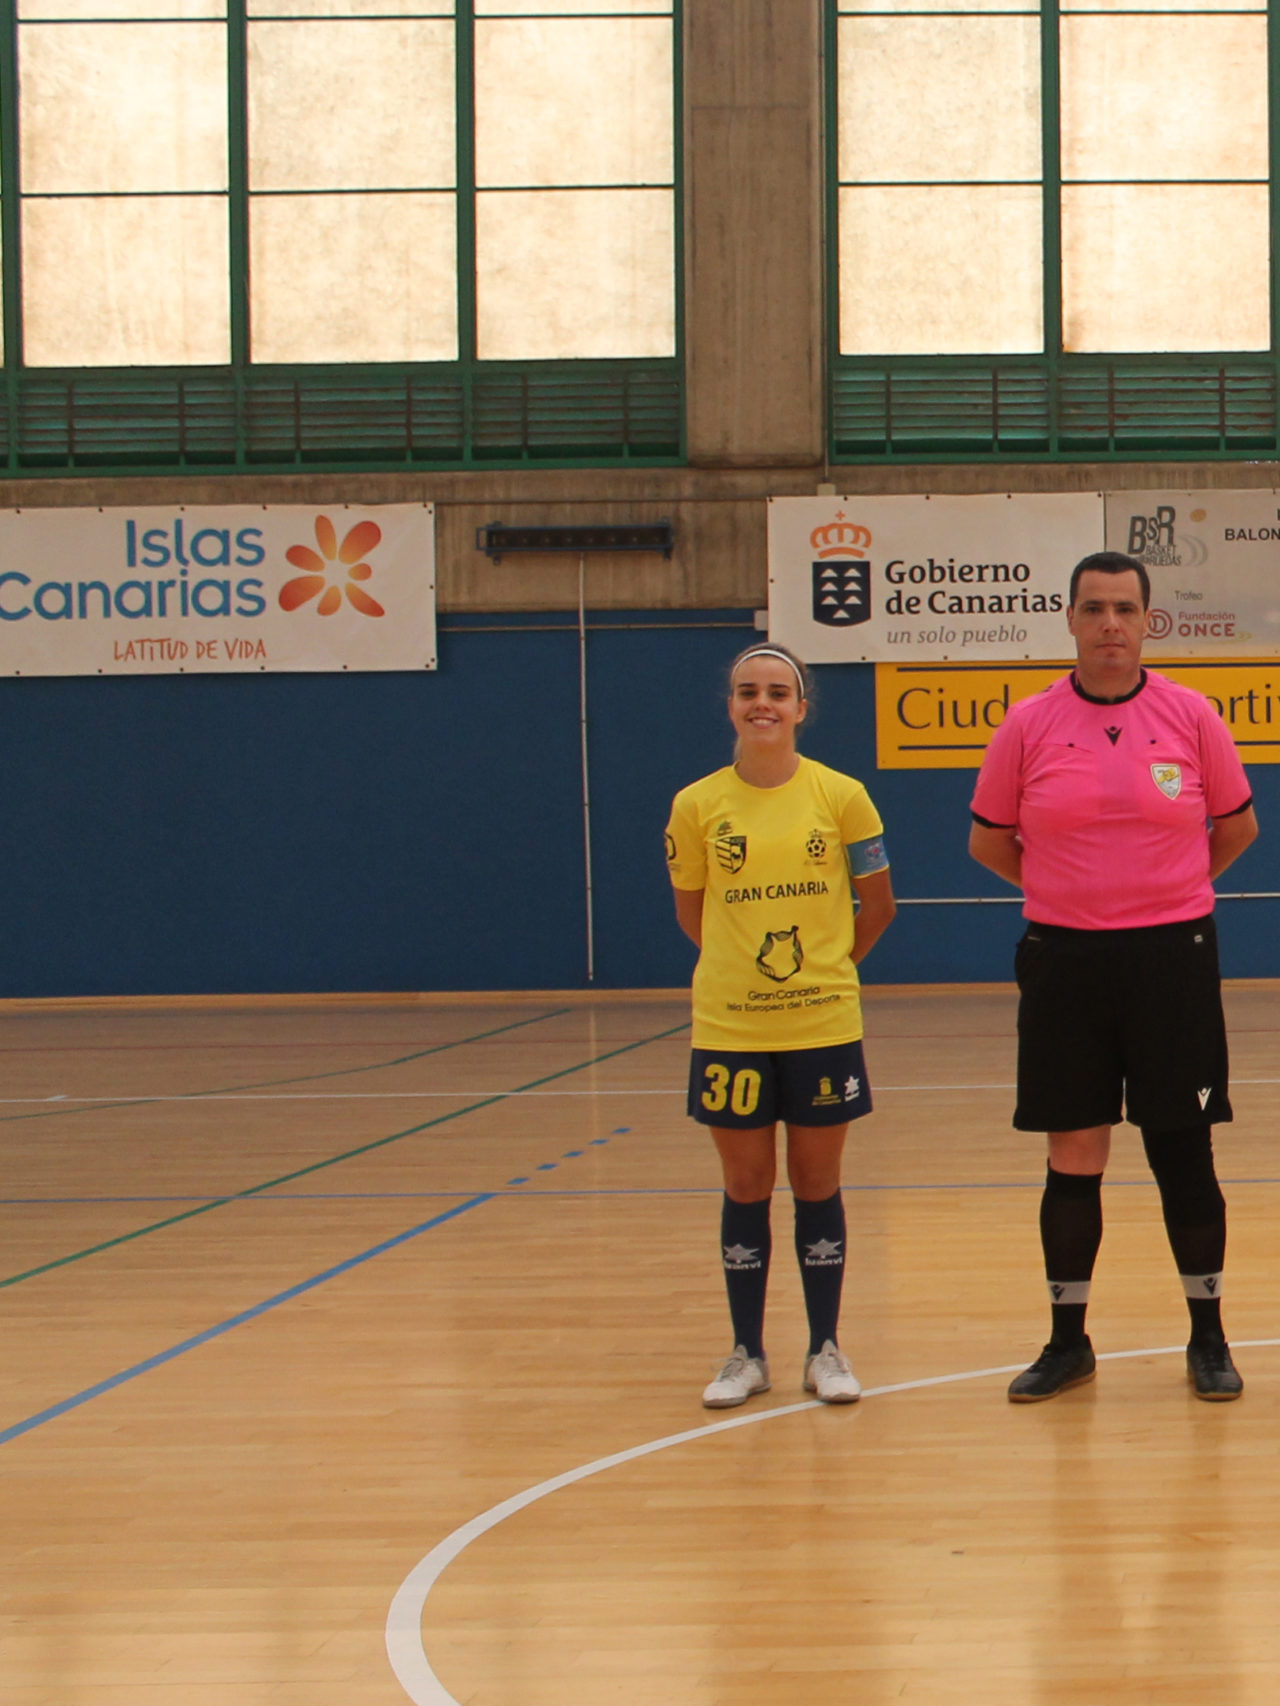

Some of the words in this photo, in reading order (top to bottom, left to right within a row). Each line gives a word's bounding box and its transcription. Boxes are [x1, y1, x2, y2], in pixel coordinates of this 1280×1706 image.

[1127, 505, 1176, 555] BSR
[126, 518, 266, 568] Islas
[885, 558, 1031, 585] Gobierno
[0, 568, 266, 621] Canarias
[885, 589, 921, 615] de
[927, 588, 1063, 615] Canarias
[1175, 589, 1203, 601] Trofeo
[1178, 610, 1236, 621] Fundación
[887, 631, 912, 644] un
[917, 626, 956, 644] solo
[961, 624, 1028, 647] pueblo
[1178, 623, 1236, 637] ONCE
[114, 638, 188, 662] LATITUD
[195, 640, 218, 660] DE
[224, 638, 266, 661] VIDA
[897, 684, 1009, 729] Ciud
[725, 886, 762, 904] GRAN
[765, 881, 829, 900] CANARIA
[747, 990, 775, 1001] Gran
[776, 986, 820, 1000] Canaria
[744, 1003, 784, 1012] Europea
[701, 1063, 761, 1116] 30
